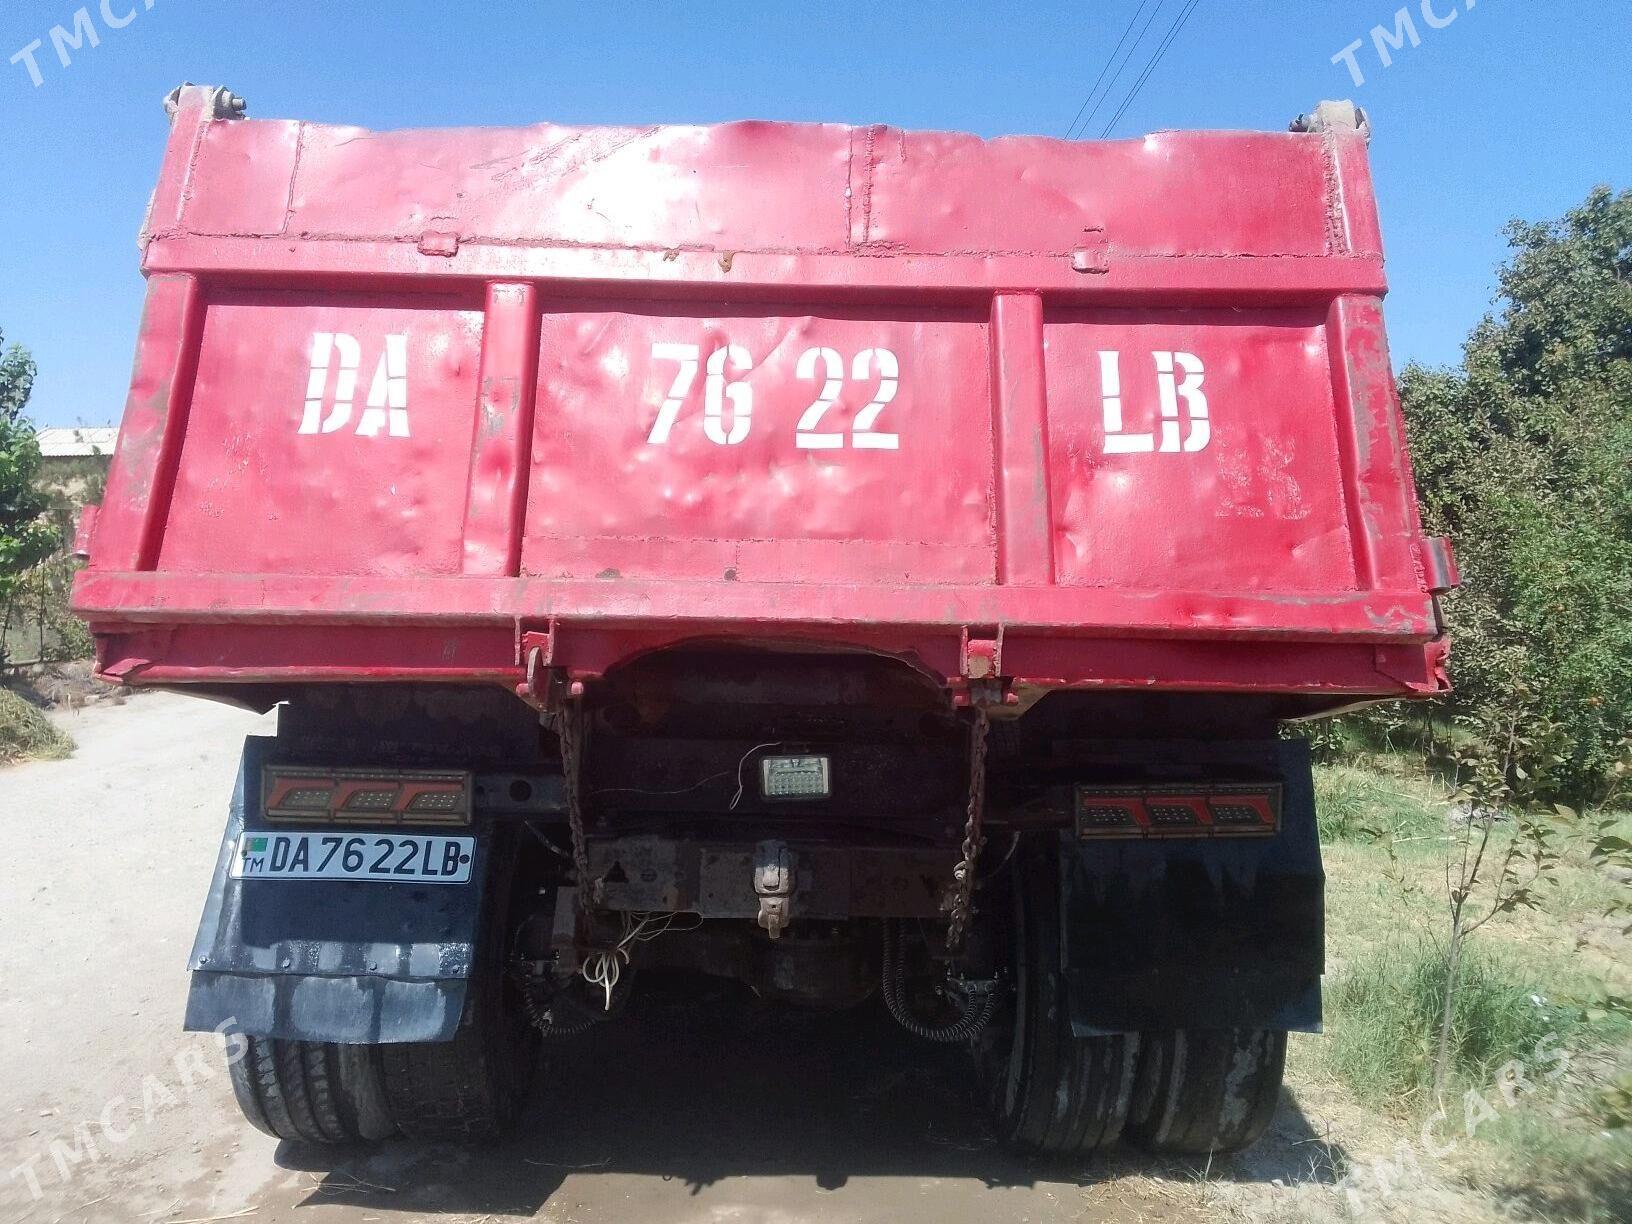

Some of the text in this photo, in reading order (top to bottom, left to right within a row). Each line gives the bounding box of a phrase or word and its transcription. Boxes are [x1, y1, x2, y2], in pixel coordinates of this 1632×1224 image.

[298, 332, 1211, 454] DA 76 22 LB
[242, 857, 264, 873] TM
